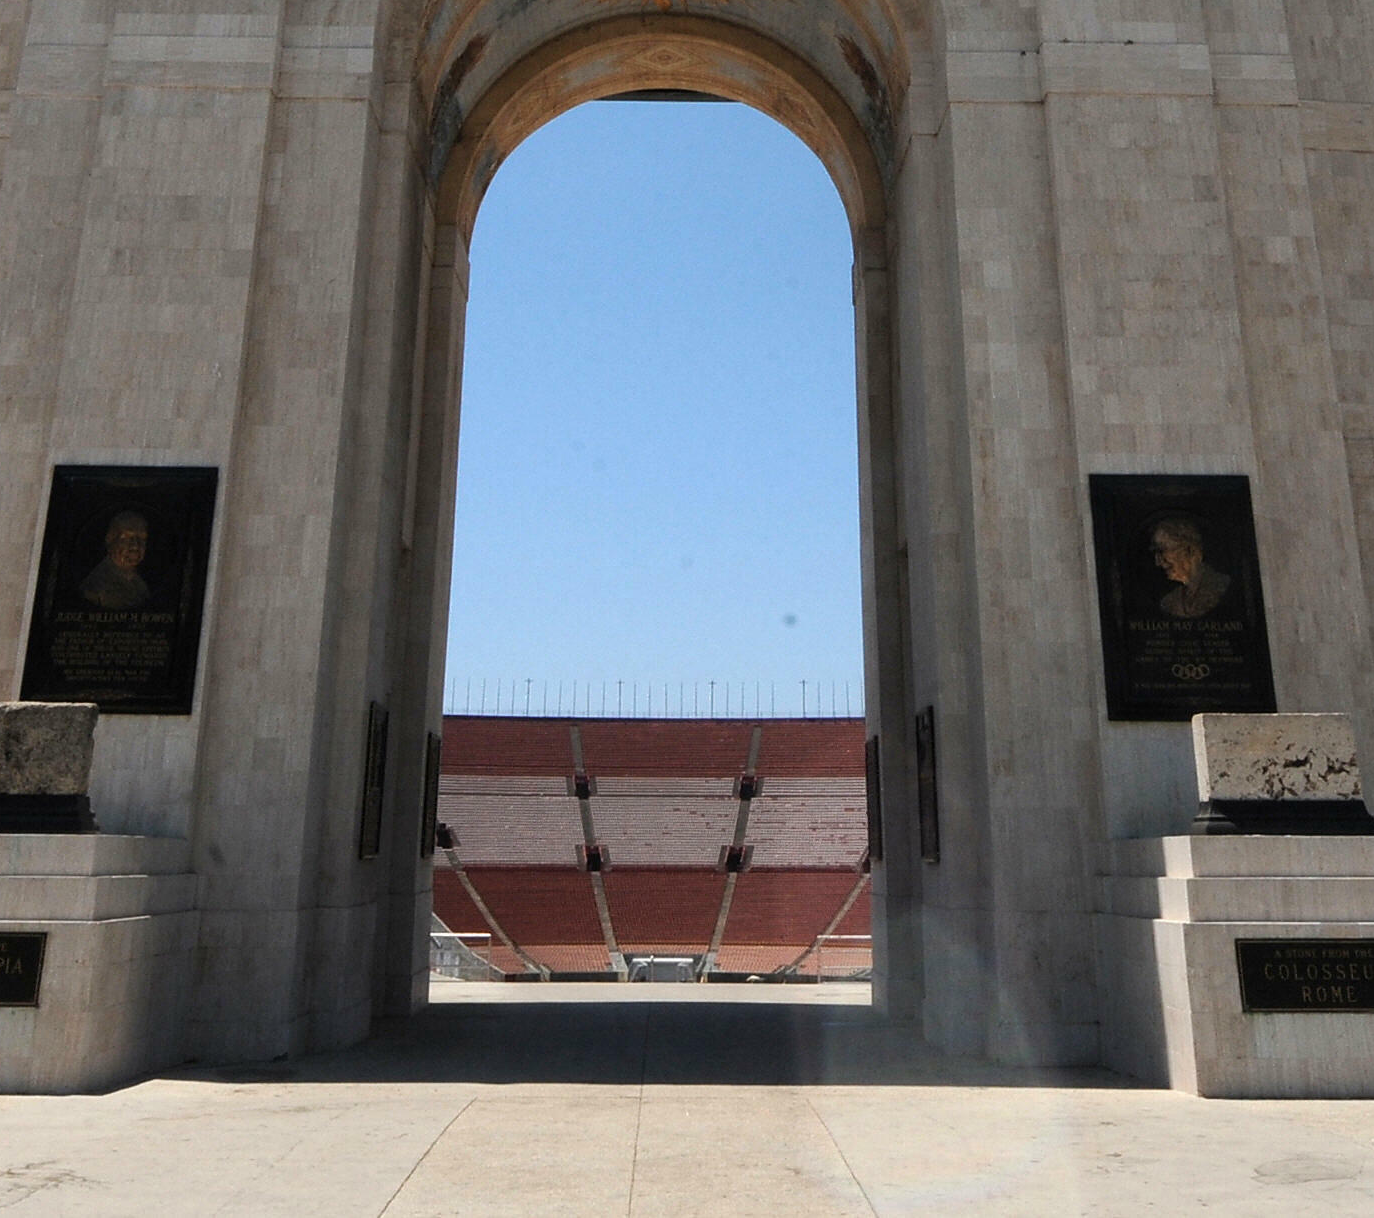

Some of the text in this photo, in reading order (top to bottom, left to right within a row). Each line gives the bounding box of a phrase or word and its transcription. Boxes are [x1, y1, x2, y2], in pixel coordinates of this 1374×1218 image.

[1273, 949, 1282, 958] A
[1285, 949, 1317, 958] STONE
[1322, 949, 1350, 958] FROM
[1301, 985, 1358, 1003] ROME
